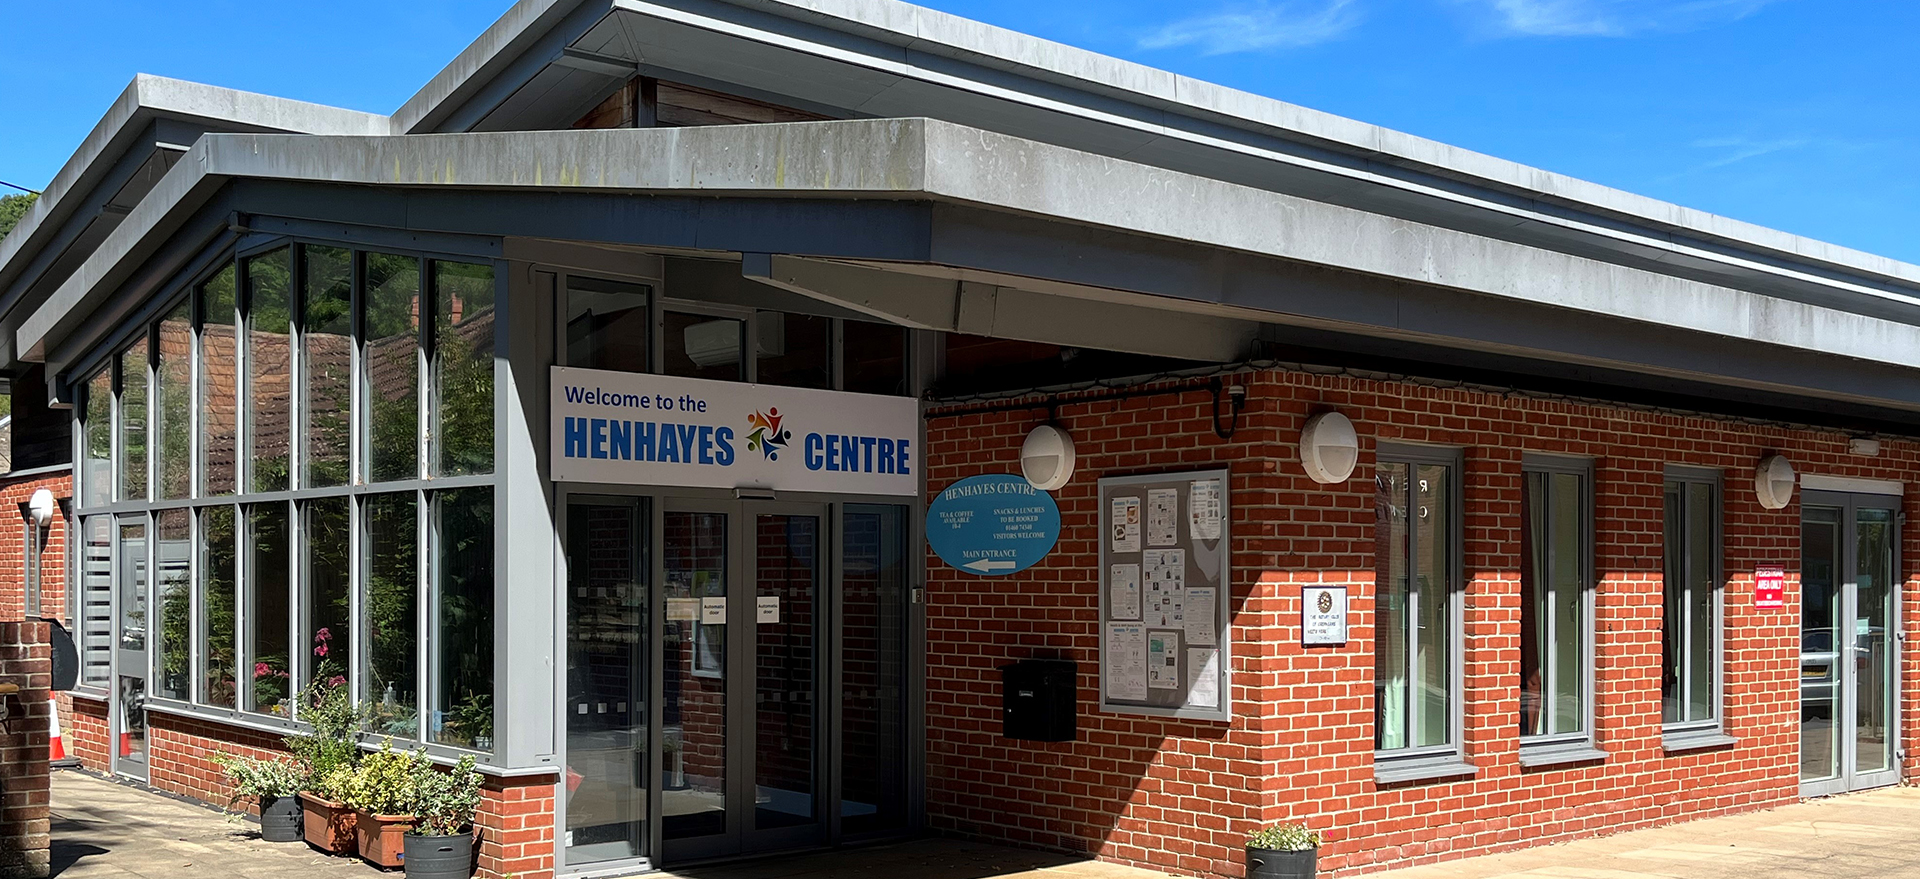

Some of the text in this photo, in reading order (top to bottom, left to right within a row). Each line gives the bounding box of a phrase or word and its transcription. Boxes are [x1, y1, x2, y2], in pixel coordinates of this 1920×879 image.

[564, 386, 707, 413] Welcome to the
[564, 416, 910, 475] HENHAYES CENTRE
[945, 482, 1037, 501] HENHAYES CENTRE
[954, 510, 974, 518] COFFEE
[1020, 506, 1045, 514] LUNCHES
[1017, 531, 1045, 539] WELCOME
[962, 549, 1017, 558] MAIN ENTRANCE
[1757, 579, 1782, 590] AREA ONLY
